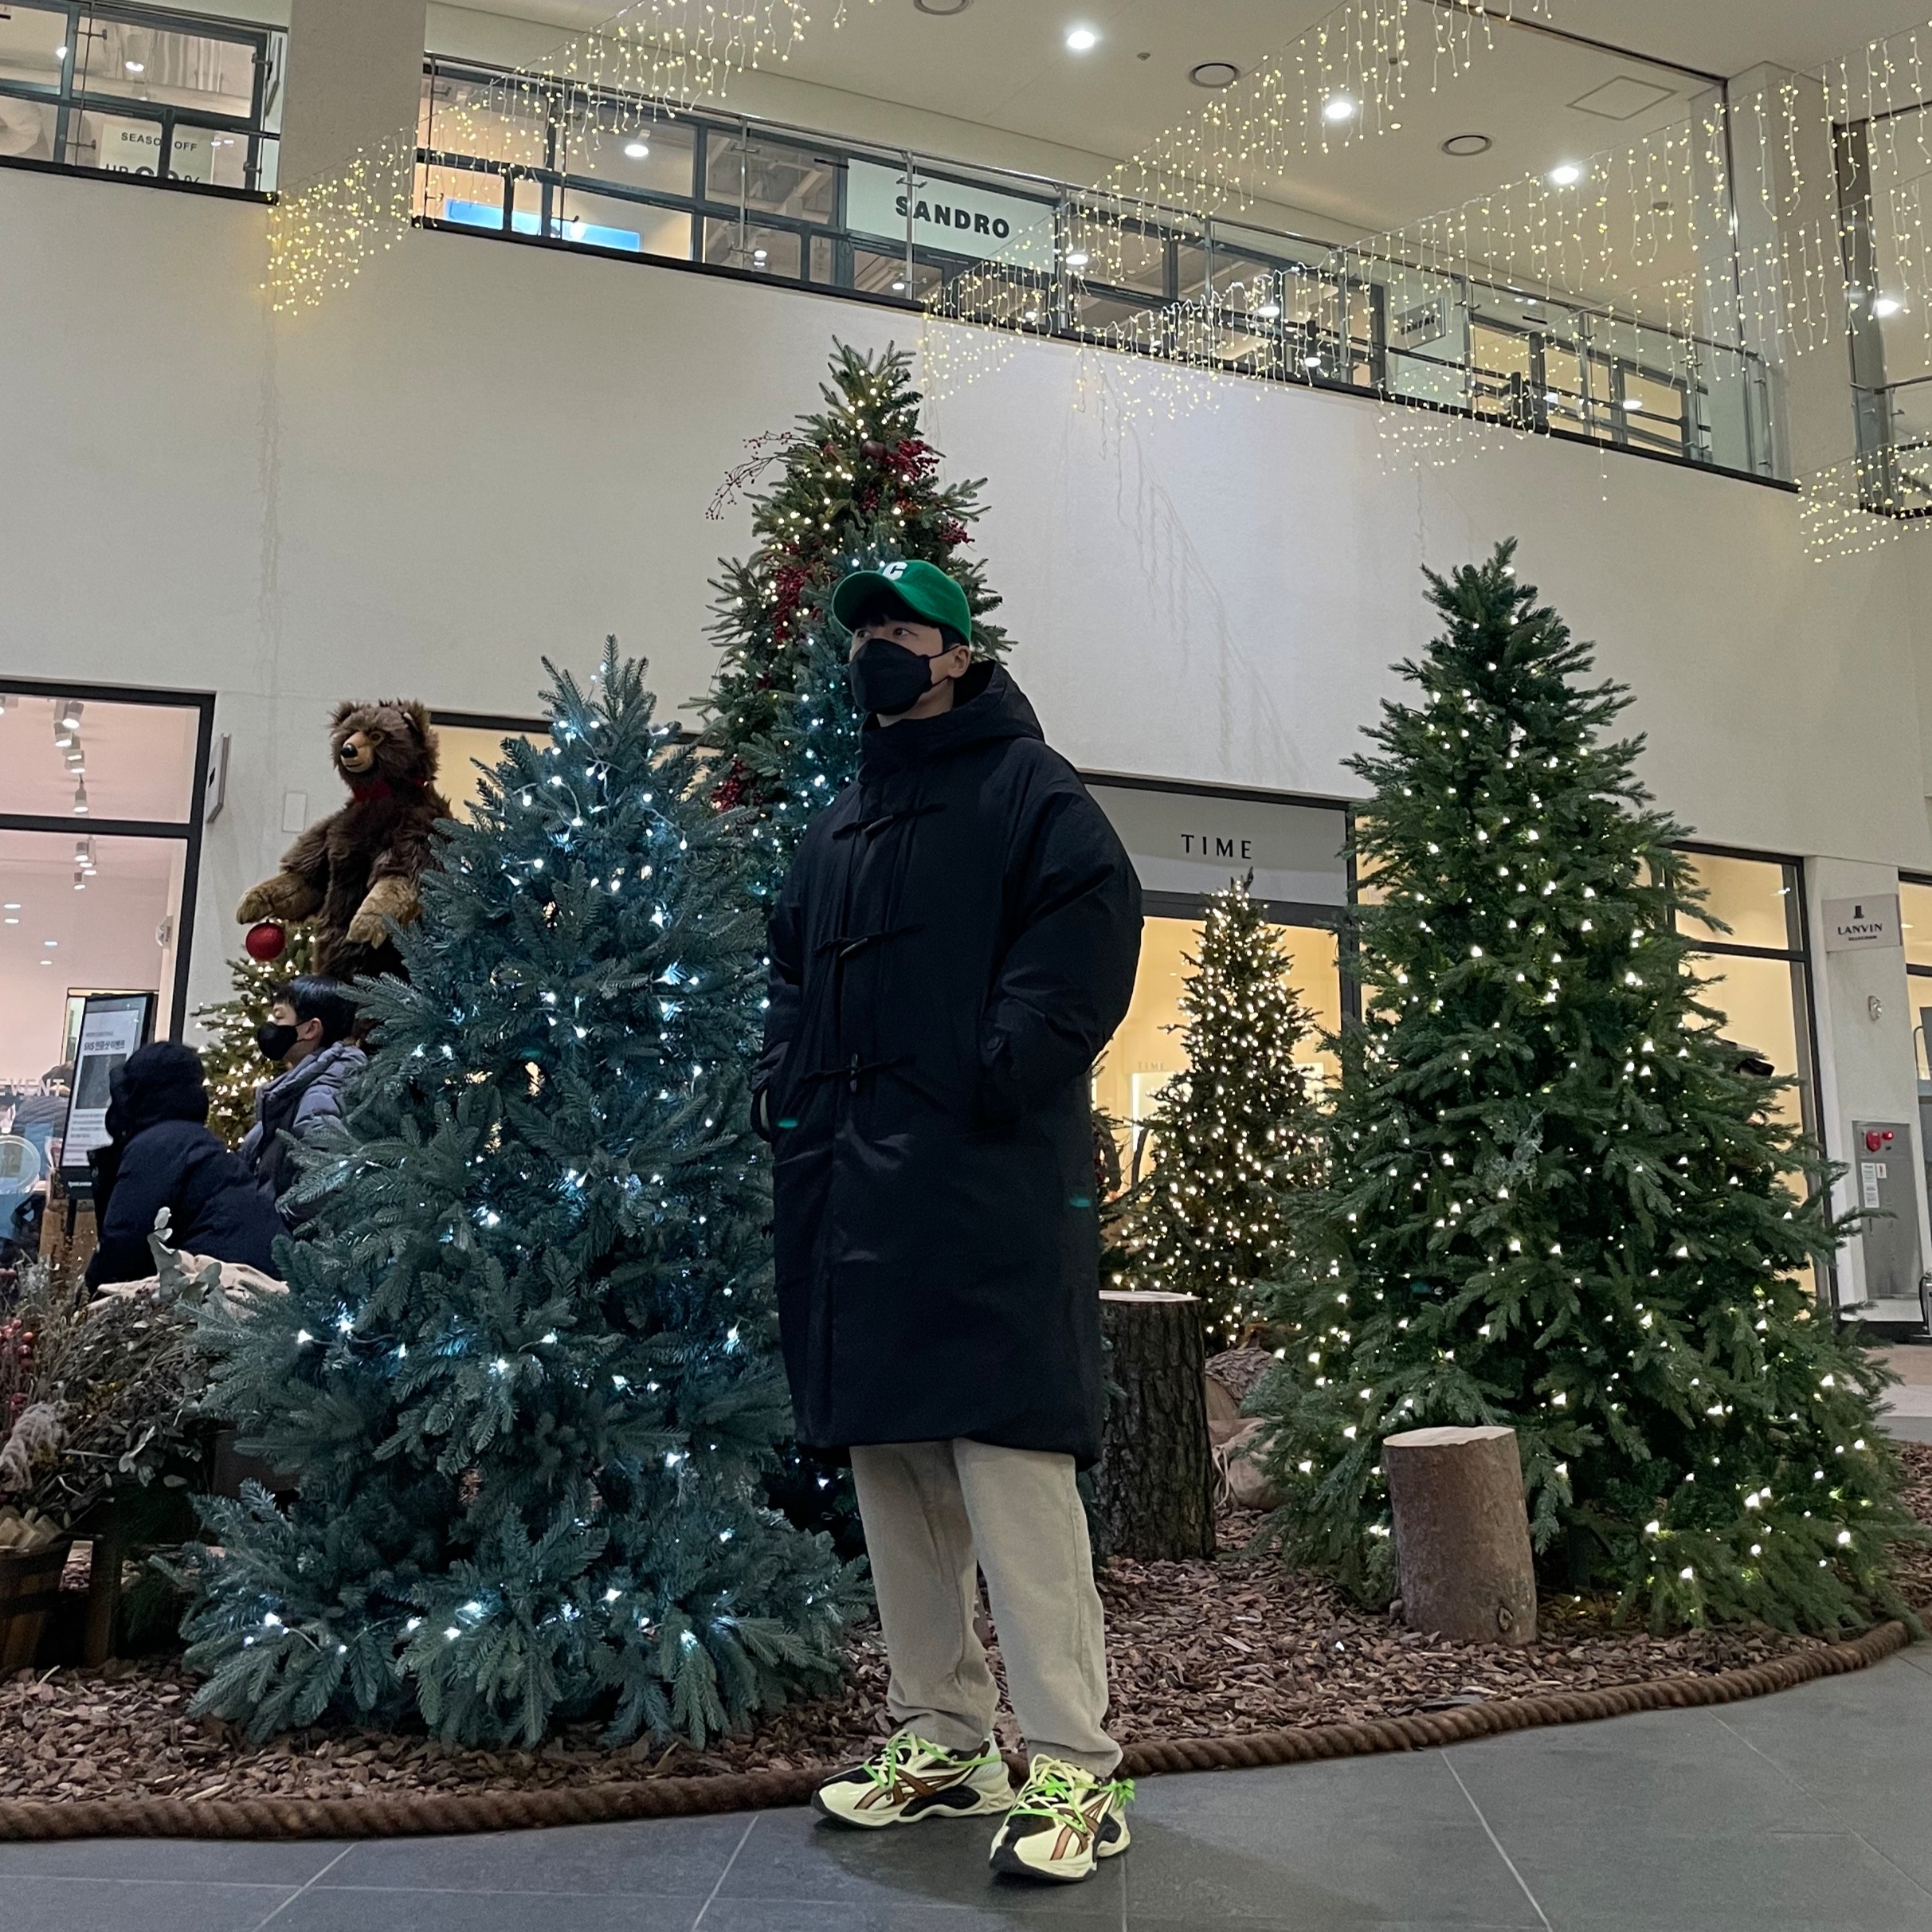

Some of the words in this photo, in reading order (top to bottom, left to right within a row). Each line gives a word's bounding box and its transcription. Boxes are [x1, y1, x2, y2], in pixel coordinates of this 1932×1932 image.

[121, 131, 162, 146] SEASO
[174, 141, 198, 152] OFF
[895, 196, 1009, 238] SANDRO
[1181, 833, 1252, 859] TIME
[1837, 923, 1883, 935] LANVIN
[0, 1078, 65, 1097] EVENT
